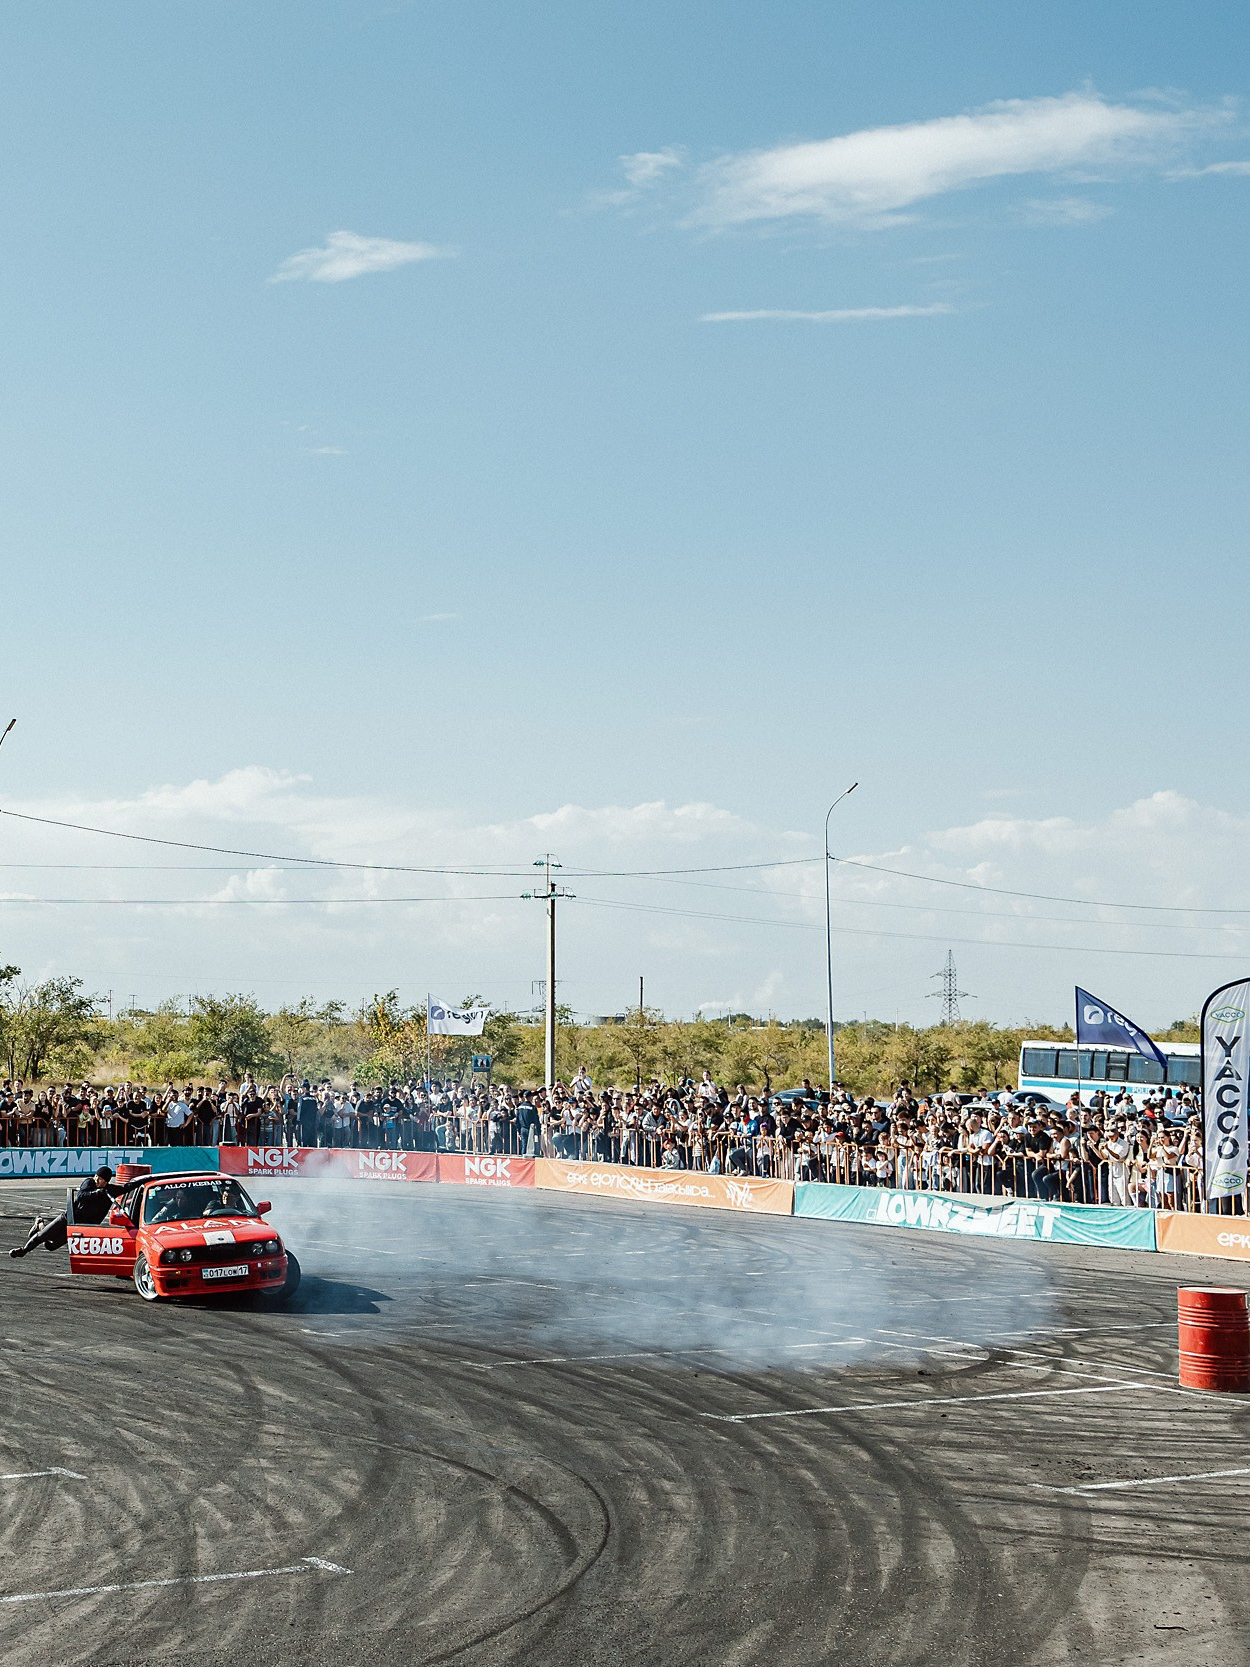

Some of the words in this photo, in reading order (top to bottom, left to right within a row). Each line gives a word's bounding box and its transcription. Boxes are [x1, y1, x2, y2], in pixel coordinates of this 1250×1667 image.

[1214, 1035, 1243, 1161] YACCO
[247, 1149, 299, 1168] NGK
[358, 1152, 408, 1172] NGK
[464, 1157, 511, 1178] NGK
[248, 1168, 275, 1176] SPARK
[276, 1168, 299, 1176] PLUGS
[465, 1178, 487, 1186] SPARK
[488, 1179, 511, 1187] PLUGS
[67, 1237, 124, 1255] KEBAB
